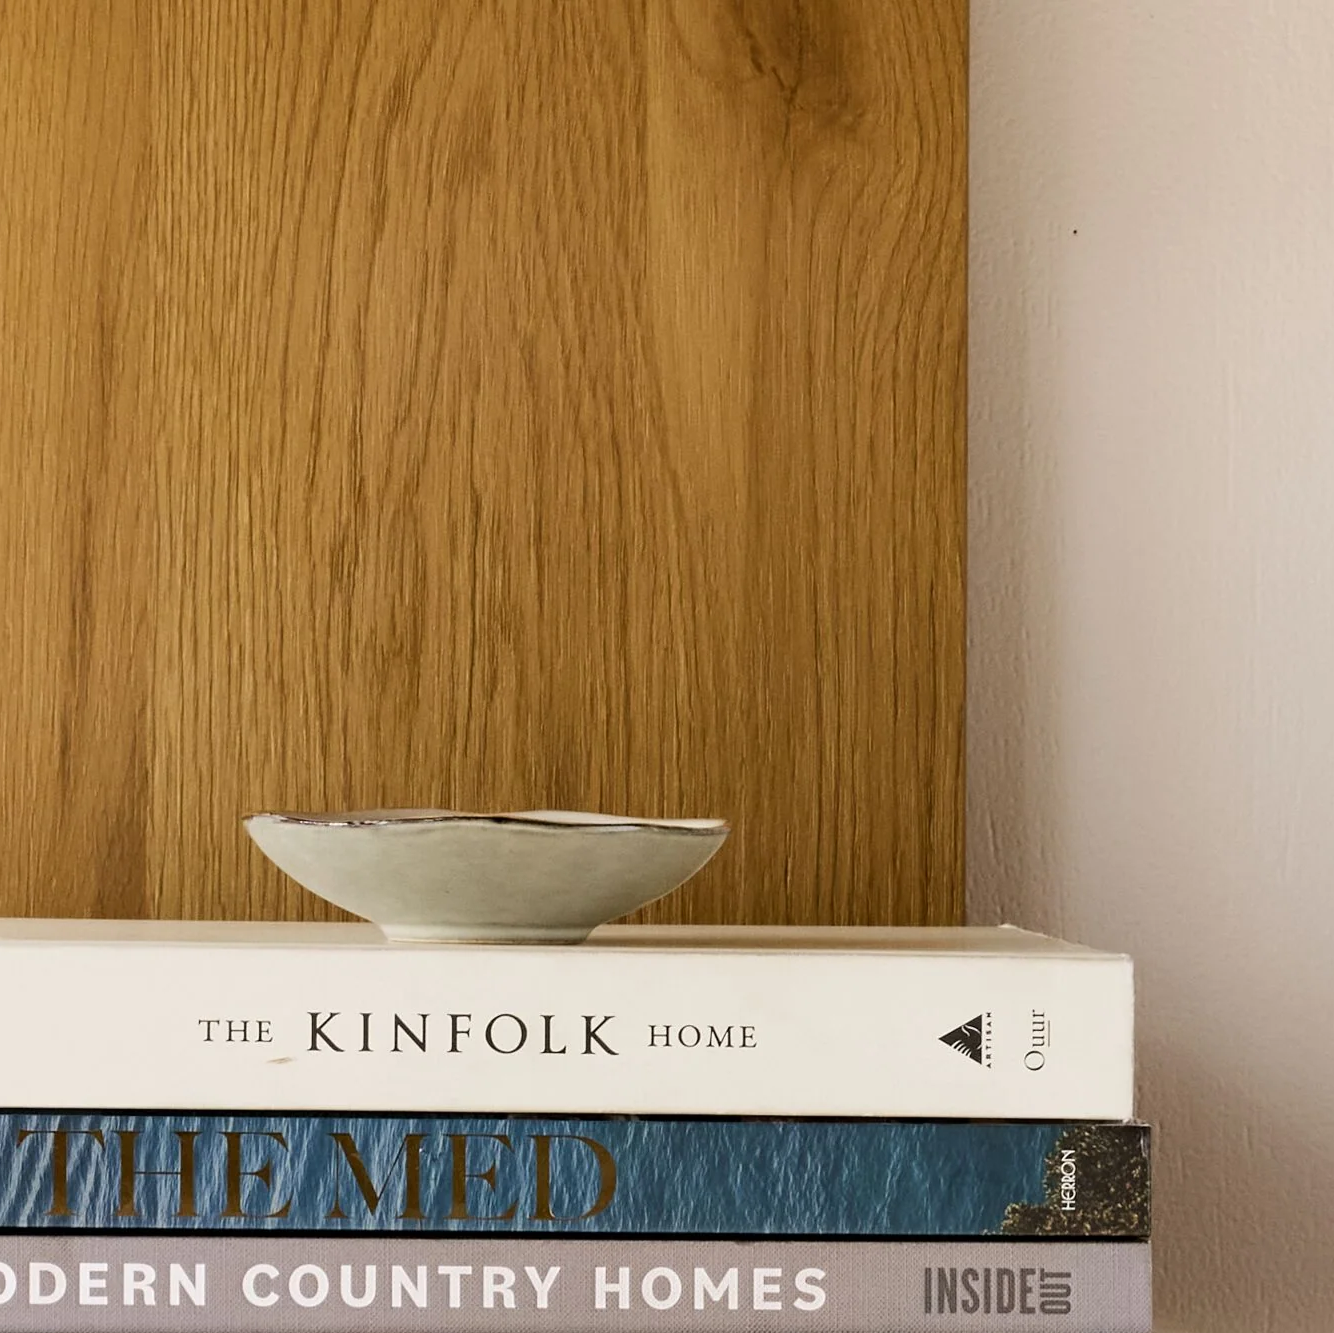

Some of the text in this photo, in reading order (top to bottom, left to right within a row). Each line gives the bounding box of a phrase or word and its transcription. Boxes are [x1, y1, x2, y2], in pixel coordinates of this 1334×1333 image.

[198, 1011, 758, 1056] THE KINFOLK HOME
[1024, 1009, 1045, 1071] Ouur
[17, 1129, 618, 1222] THE MED
[1060, 1150, 1076, 1210] HERRON
[242, 1263, 562, 1309] COUNTRY
[595, 1266, 827, 1311] HOMES
[924, 1268, 1072, 1315] INSIDE OUT
